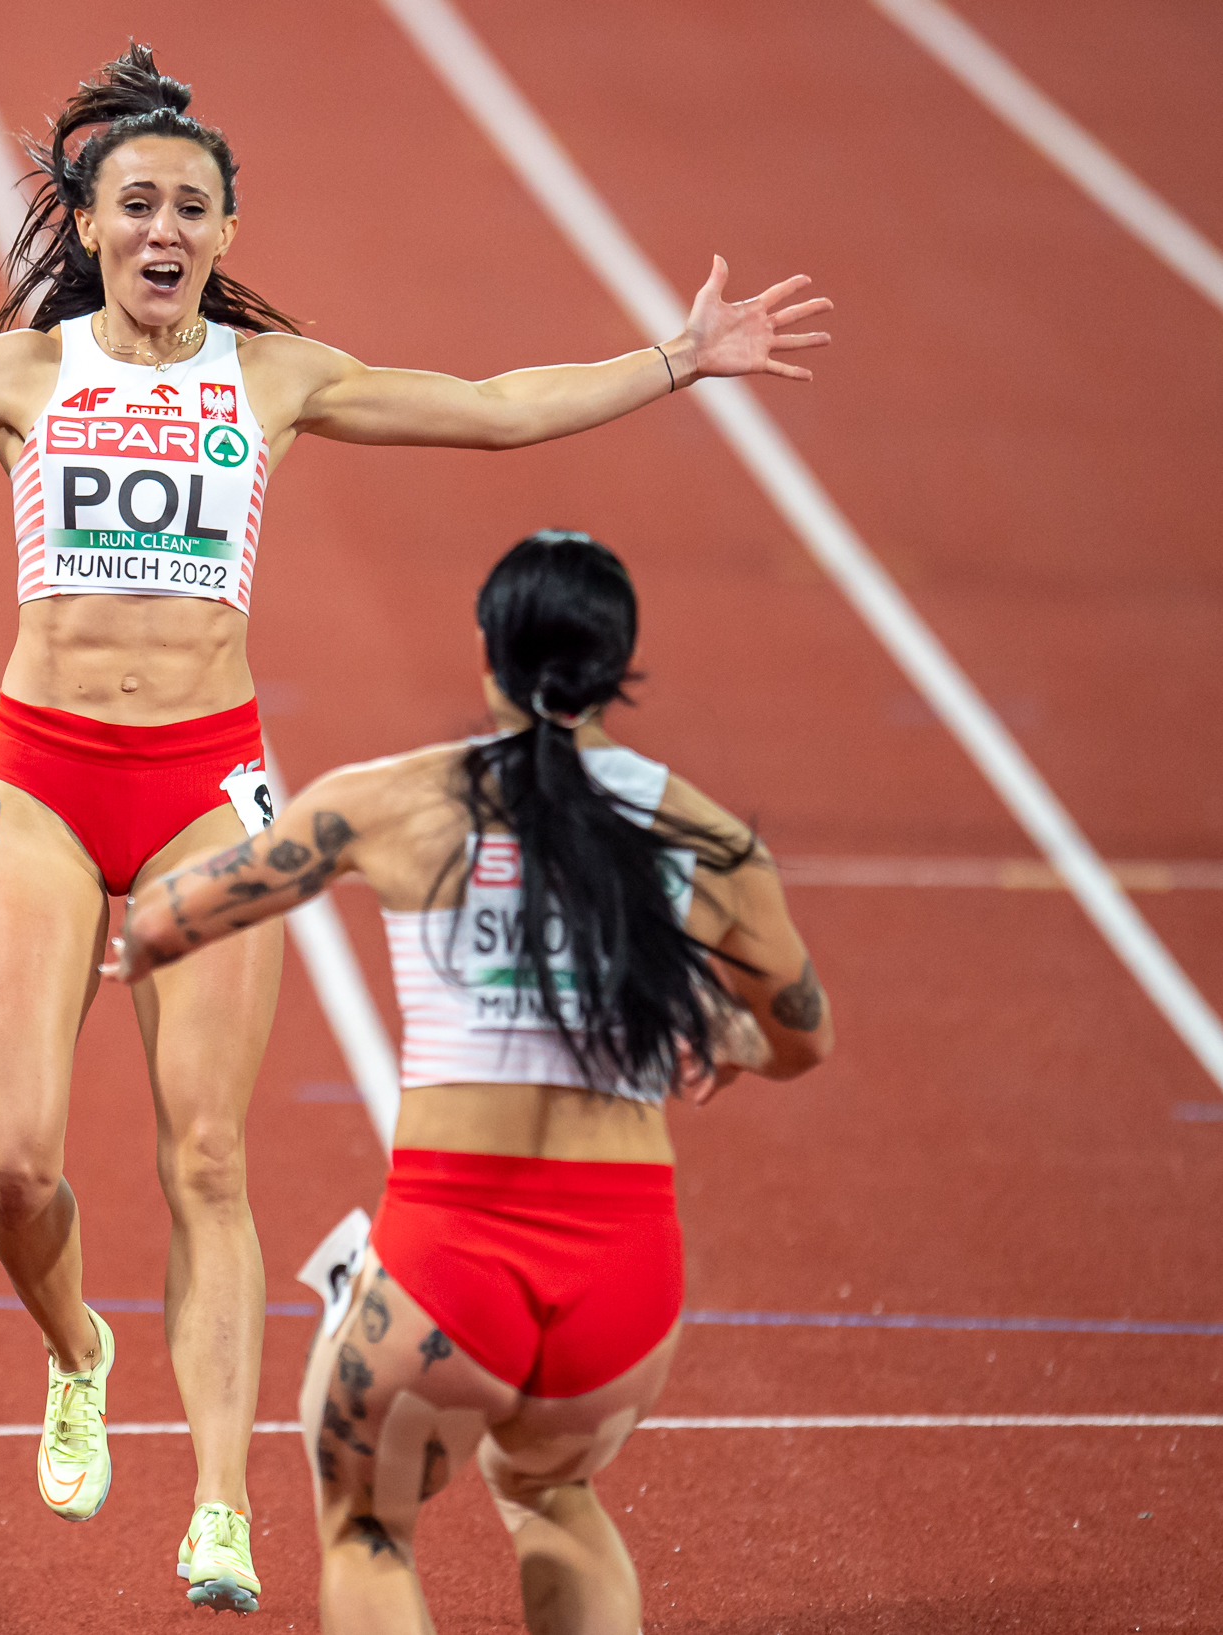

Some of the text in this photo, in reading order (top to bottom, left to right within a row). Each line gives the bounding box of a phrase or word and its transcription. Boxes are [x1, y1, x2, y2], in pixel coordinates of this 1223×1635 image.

[61, 387, 116, 412] 4F
[50, 419, 196, 457] SPAR
[63, 466, 228, 541] POL
[89, 532, 94, 546] I
[99, 532, 135, 548] RUN
[56, 553, 228, 589] MUNICH 2022
